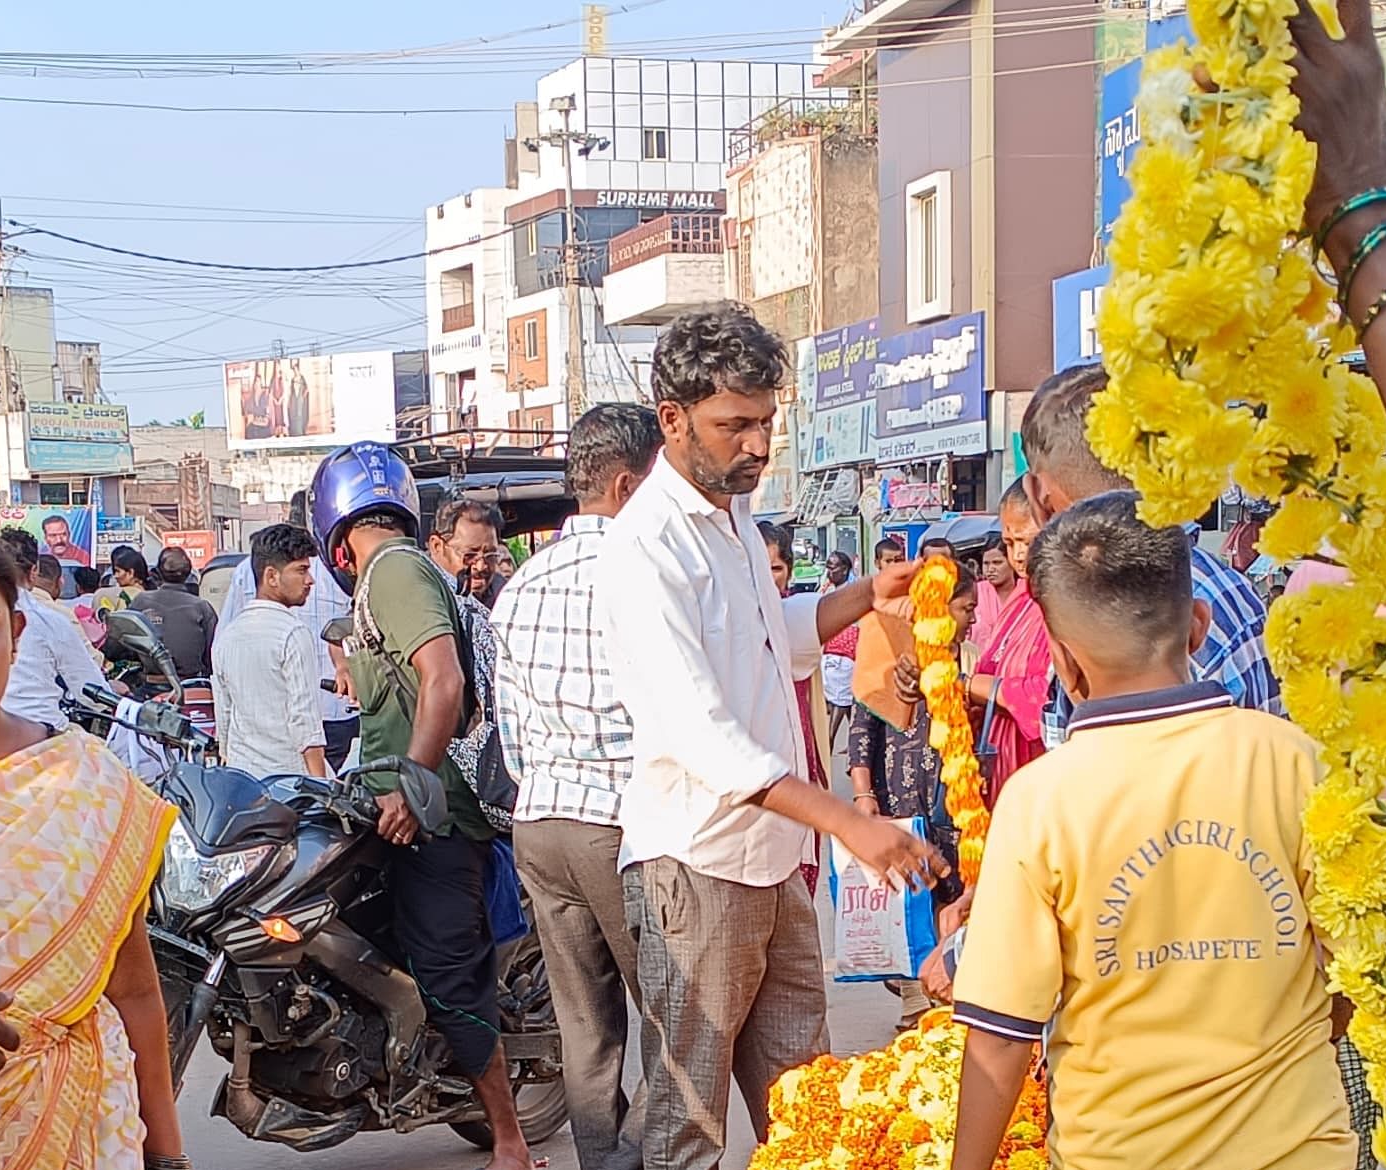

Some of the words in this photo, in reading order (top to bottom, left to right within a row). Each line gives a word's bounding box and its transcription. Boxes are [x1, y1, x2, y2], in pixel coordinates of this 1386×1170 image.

[597, 191, 668, 208] SUPREME
[672, 192, 715, 208] MALL
[1097, 818, 1237, 930] SAPTHAGIRI
[1234, 836, 1298, 957] SCHOOL
[1094, 936, 1121, 977] SRI
[1135, 938, 1262, 971] HOSAPETE
